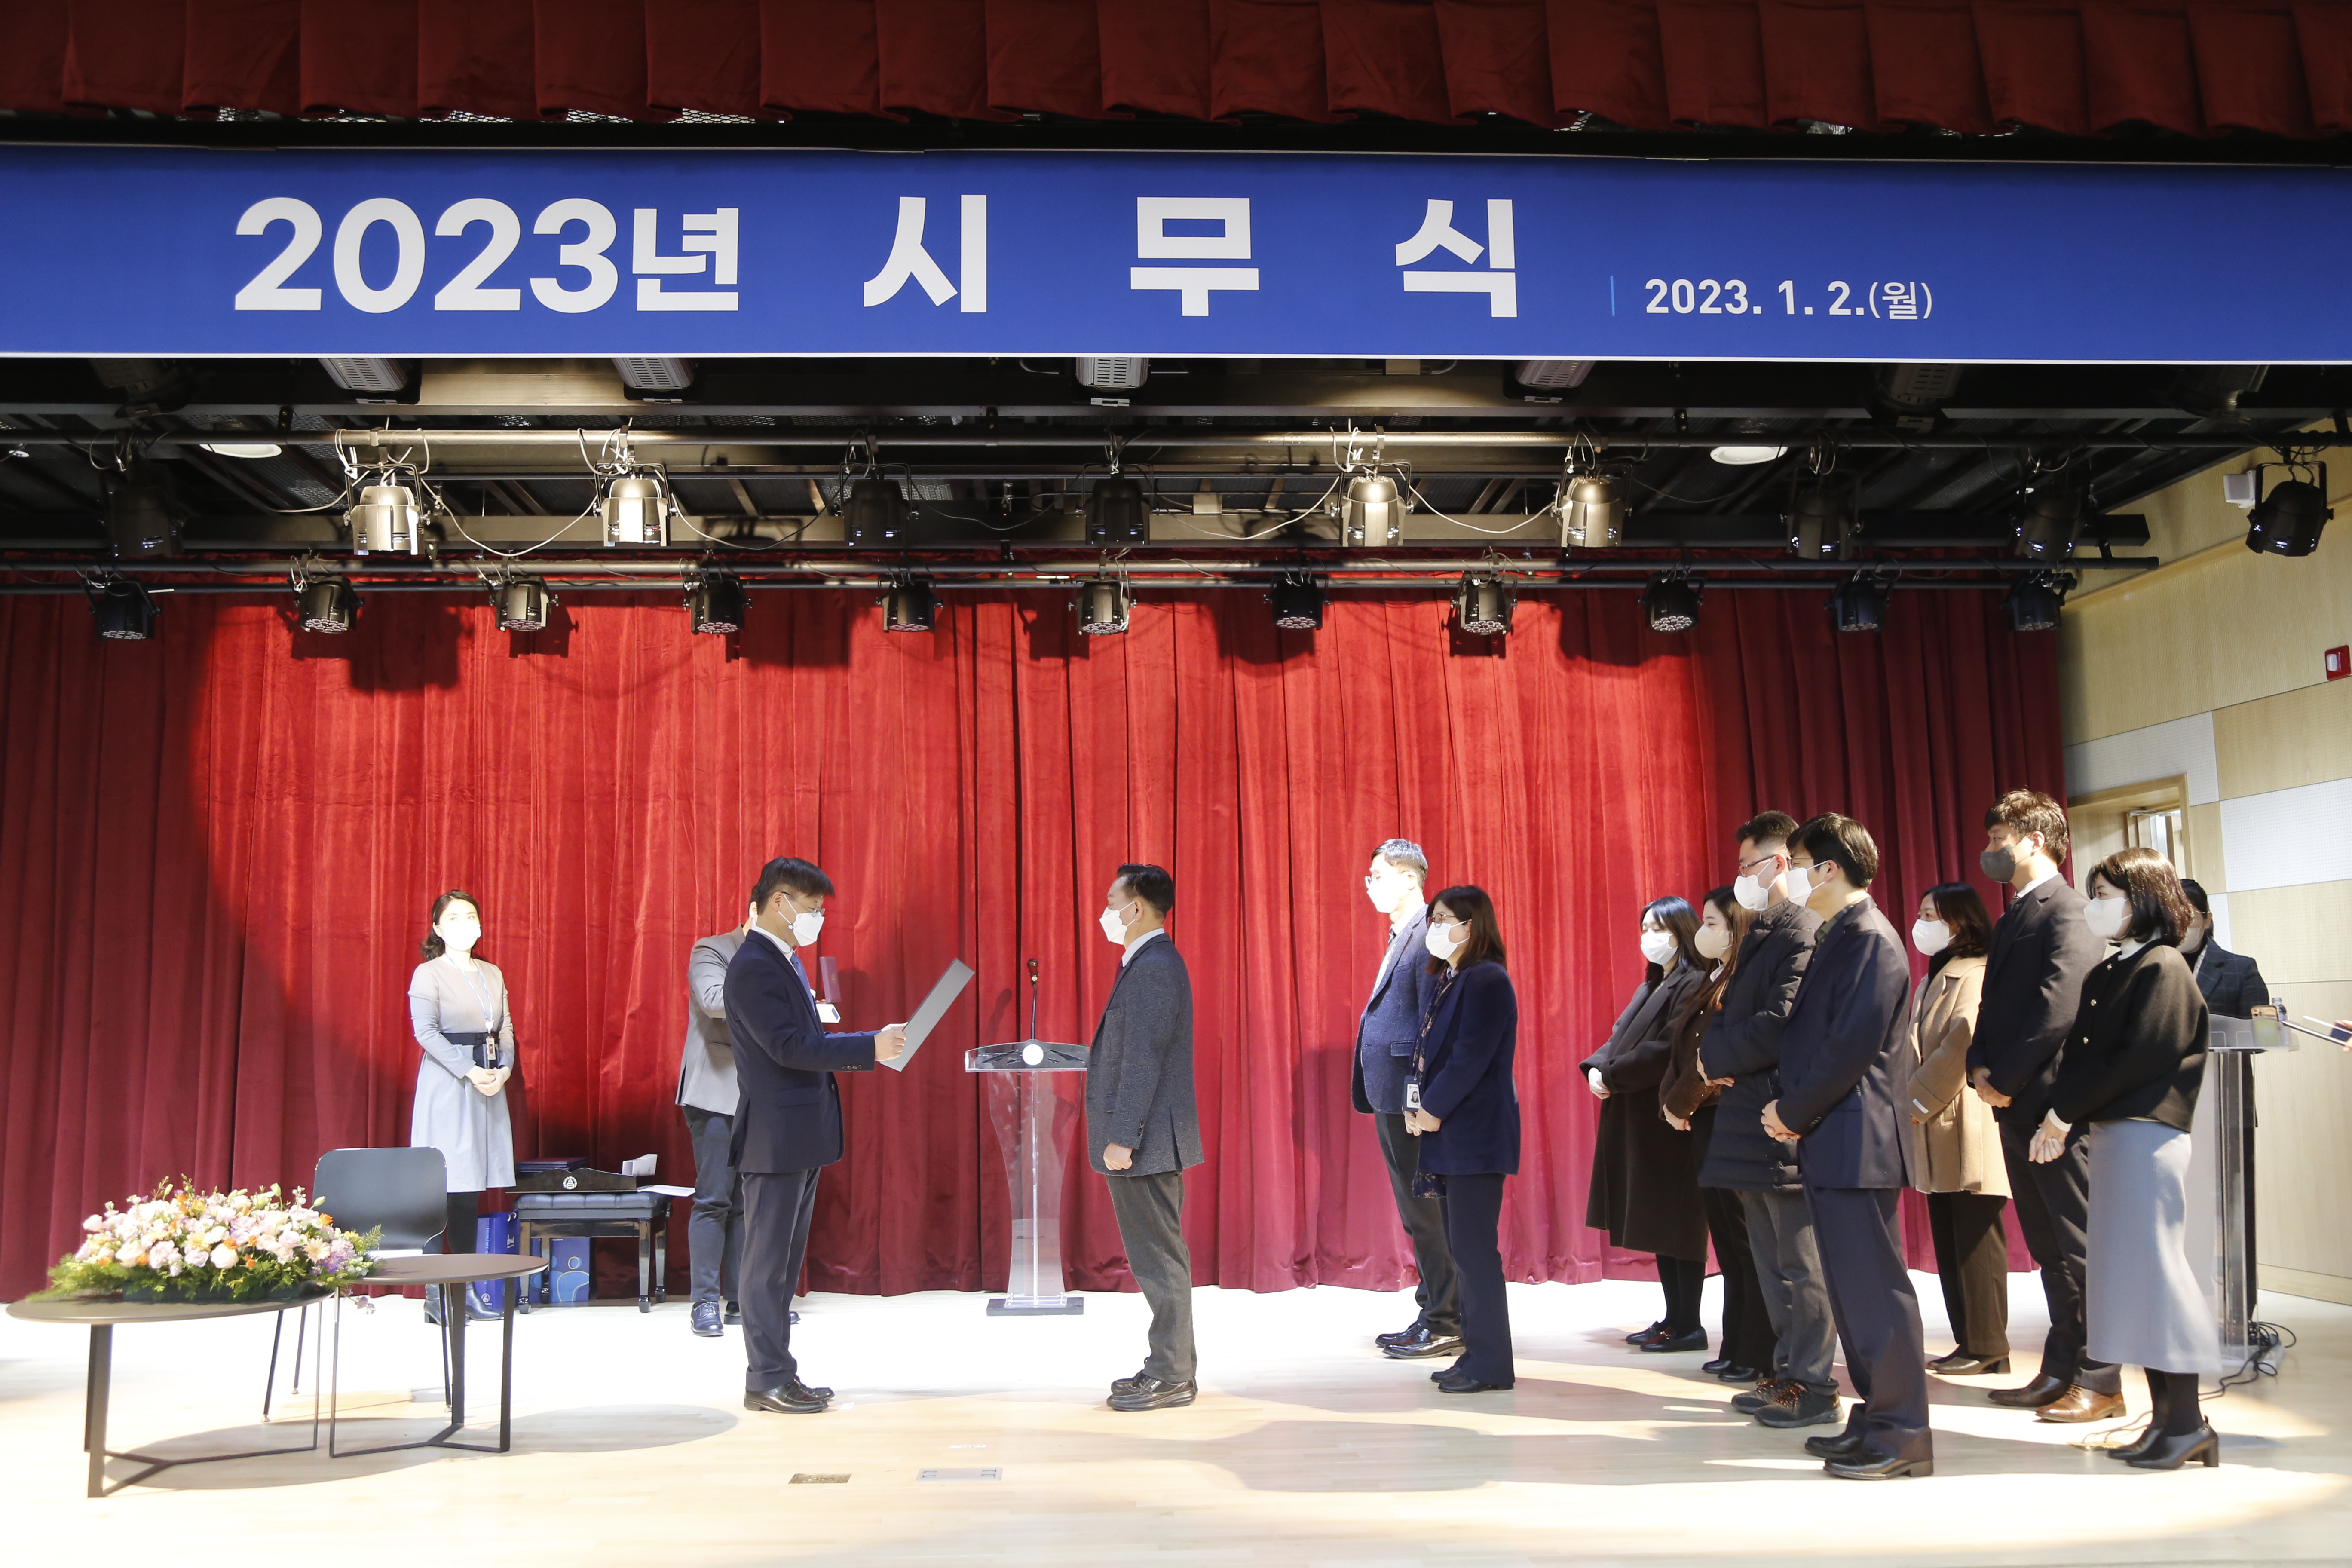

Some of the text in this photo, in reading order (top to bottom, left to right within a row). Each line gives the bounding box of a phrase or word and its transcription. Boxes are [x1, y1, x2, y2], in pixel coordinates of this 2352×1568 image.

[234, 197, 739, 314] 2023년
[1645, 278, 1762, 315] 2023.
[1778, 280, 1813, 315] 1.
